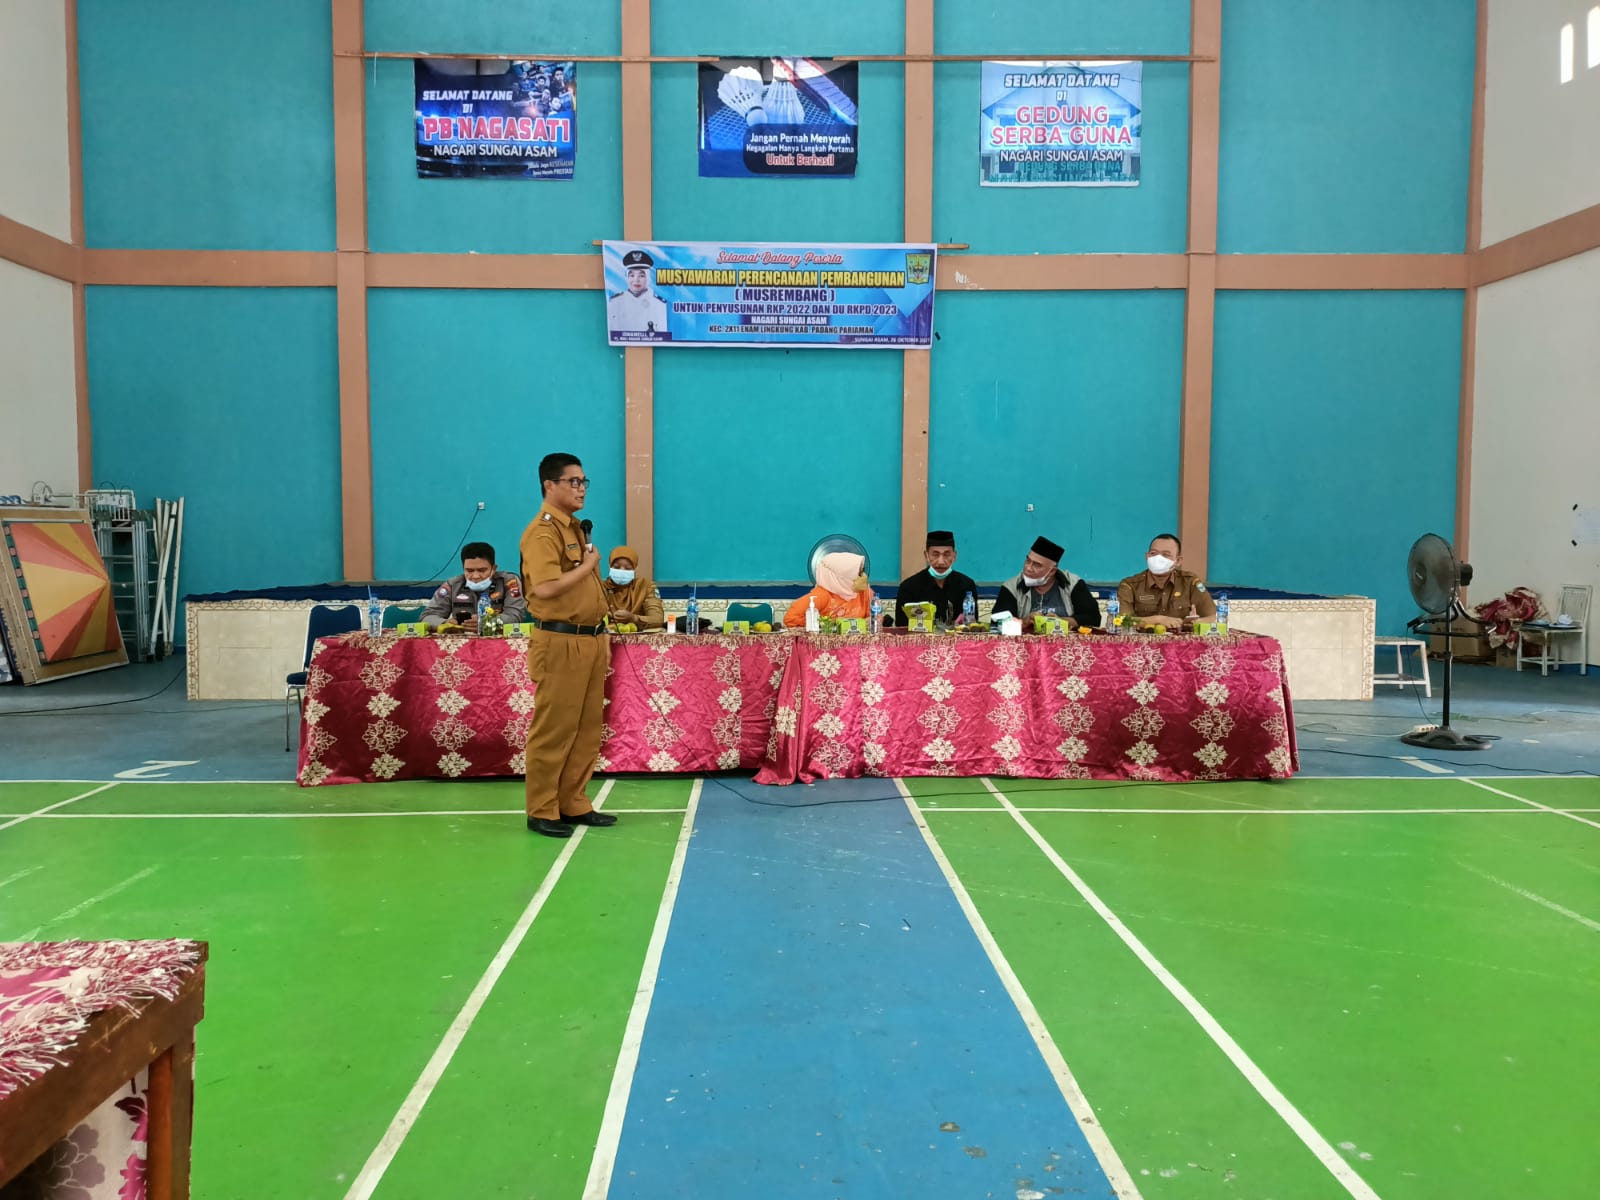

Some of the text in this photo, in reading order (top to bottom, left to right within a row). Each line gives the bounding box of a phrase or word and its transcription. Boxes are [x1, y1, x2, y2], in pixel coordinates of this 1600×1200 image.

[1004, 74, 1120, 88] SELAMAT DATANG
[423, 90, 512, 100] SELAMAT DATANG
[1056, 90, 1067, 101] DI
[462, 103, 473, 113] DI
[1016, 106, 1108, 124] GEDUNG
[423, 117, 570, 142] PB NAGASATI
[750, 133, 850, 145] Jangan Pernah Menyerah
[992, 127, 1132, 145] SERBA GUNA
[434, 145, 557, 157] NAGARI SUNGAI ASAM
[747, 144, 777, 152] Kegagalan
[801, 145, 826, 153] Langkah
[766, 154, 834, 166] Untuk Berhasil
[1001, 150, 1123, 161] NAGARI SUNGAI ASAM
[717, 251, 843, 268] Selamat Datang Peserta
[657, 269, 905, 288] MUSYAWARAH PERENCANAAN PEMBANGUNAN
[743, 289, 827, 302] MUSREMBANG
[674, 303, 897, 314] UNTUK PENYUSUNAN RKP 2022 DAN DU RKPD 2023
[751, 316, 778, 325] NAGARI
[760, 326, 794, 334] LINGKUNG
